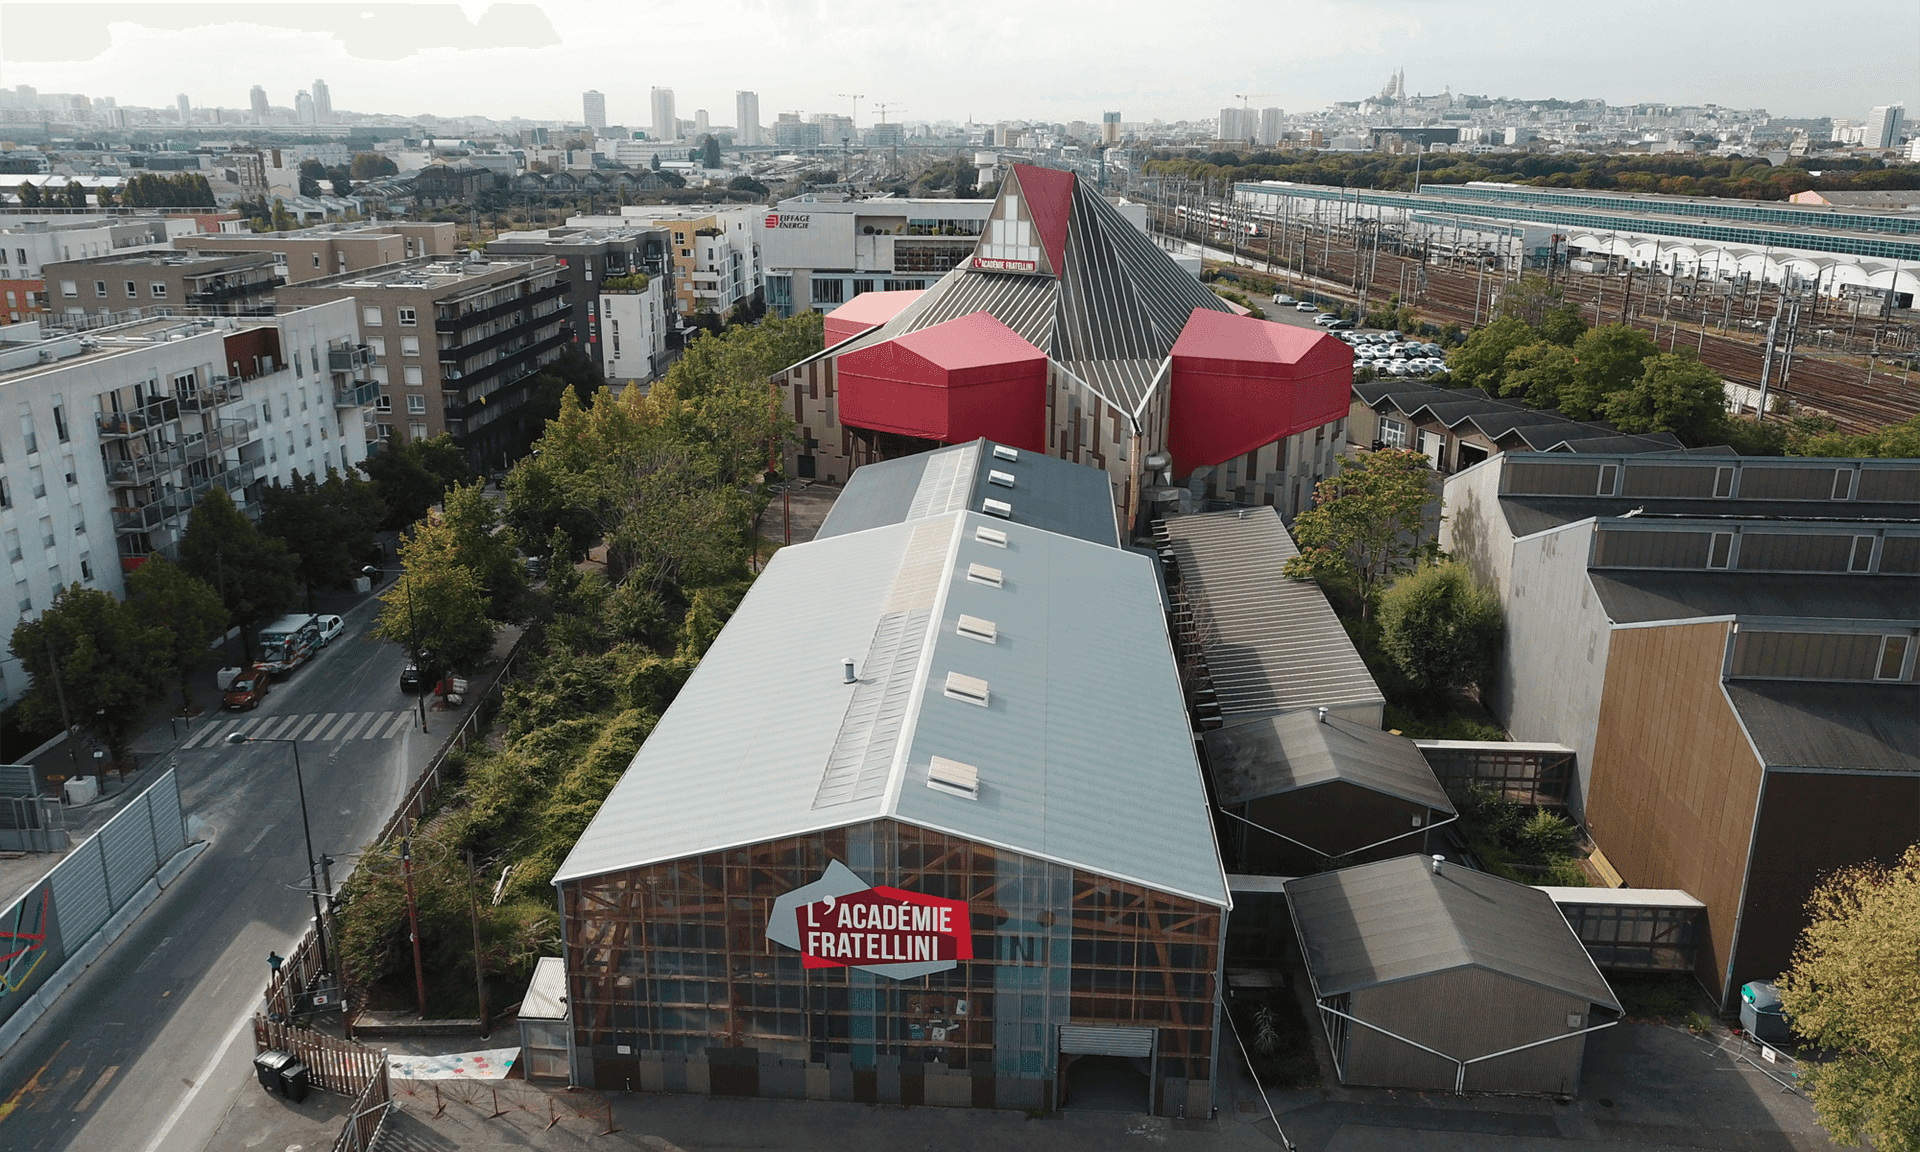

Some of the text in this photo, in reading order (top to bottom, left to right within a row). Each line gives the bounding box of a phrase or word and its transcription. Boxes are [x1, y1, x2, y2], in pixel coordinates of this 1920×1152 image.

[779, 214, 810, 222] EIFFAGE
[779, 221, 809, 229] ÉNERGIE
[1006, 261, 1034, 271] FRATELLINI
[807, 895, 952, 932] L'ACADÉMIE
[808, 932, 938, 960] FRATELLINI
